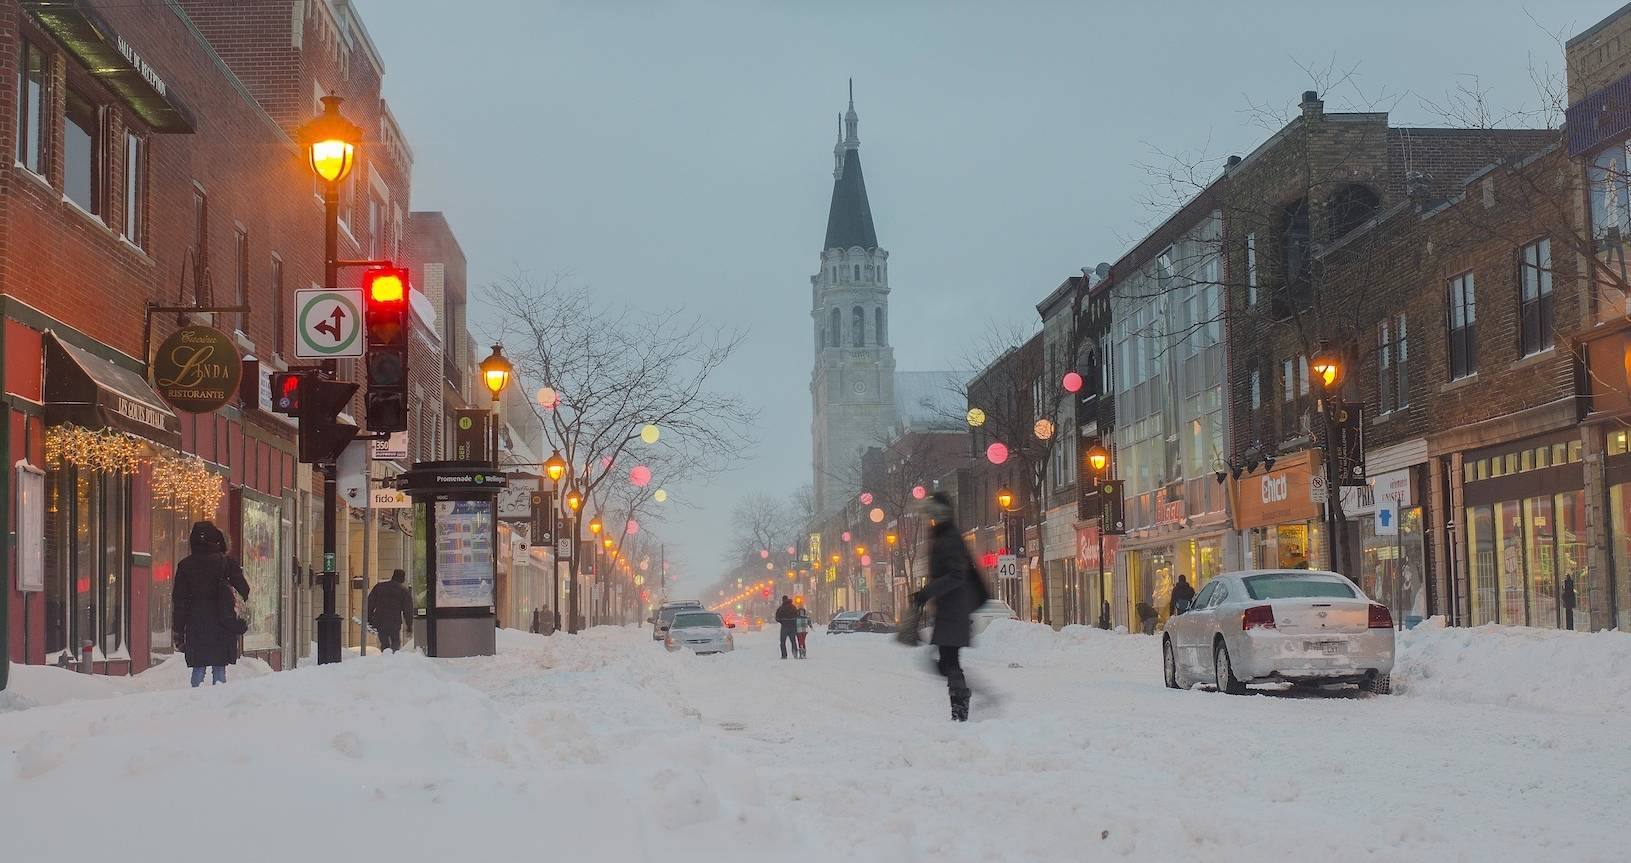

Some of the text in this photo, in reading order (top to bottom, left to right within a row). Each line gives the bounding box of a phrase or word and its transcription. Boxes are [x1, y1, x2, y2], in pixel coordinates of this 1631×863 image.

[168, 389, 225, 399] RISTORANTE
[375, 494, 394, 503] fido
[1000, 563, 1016, 576] 40
